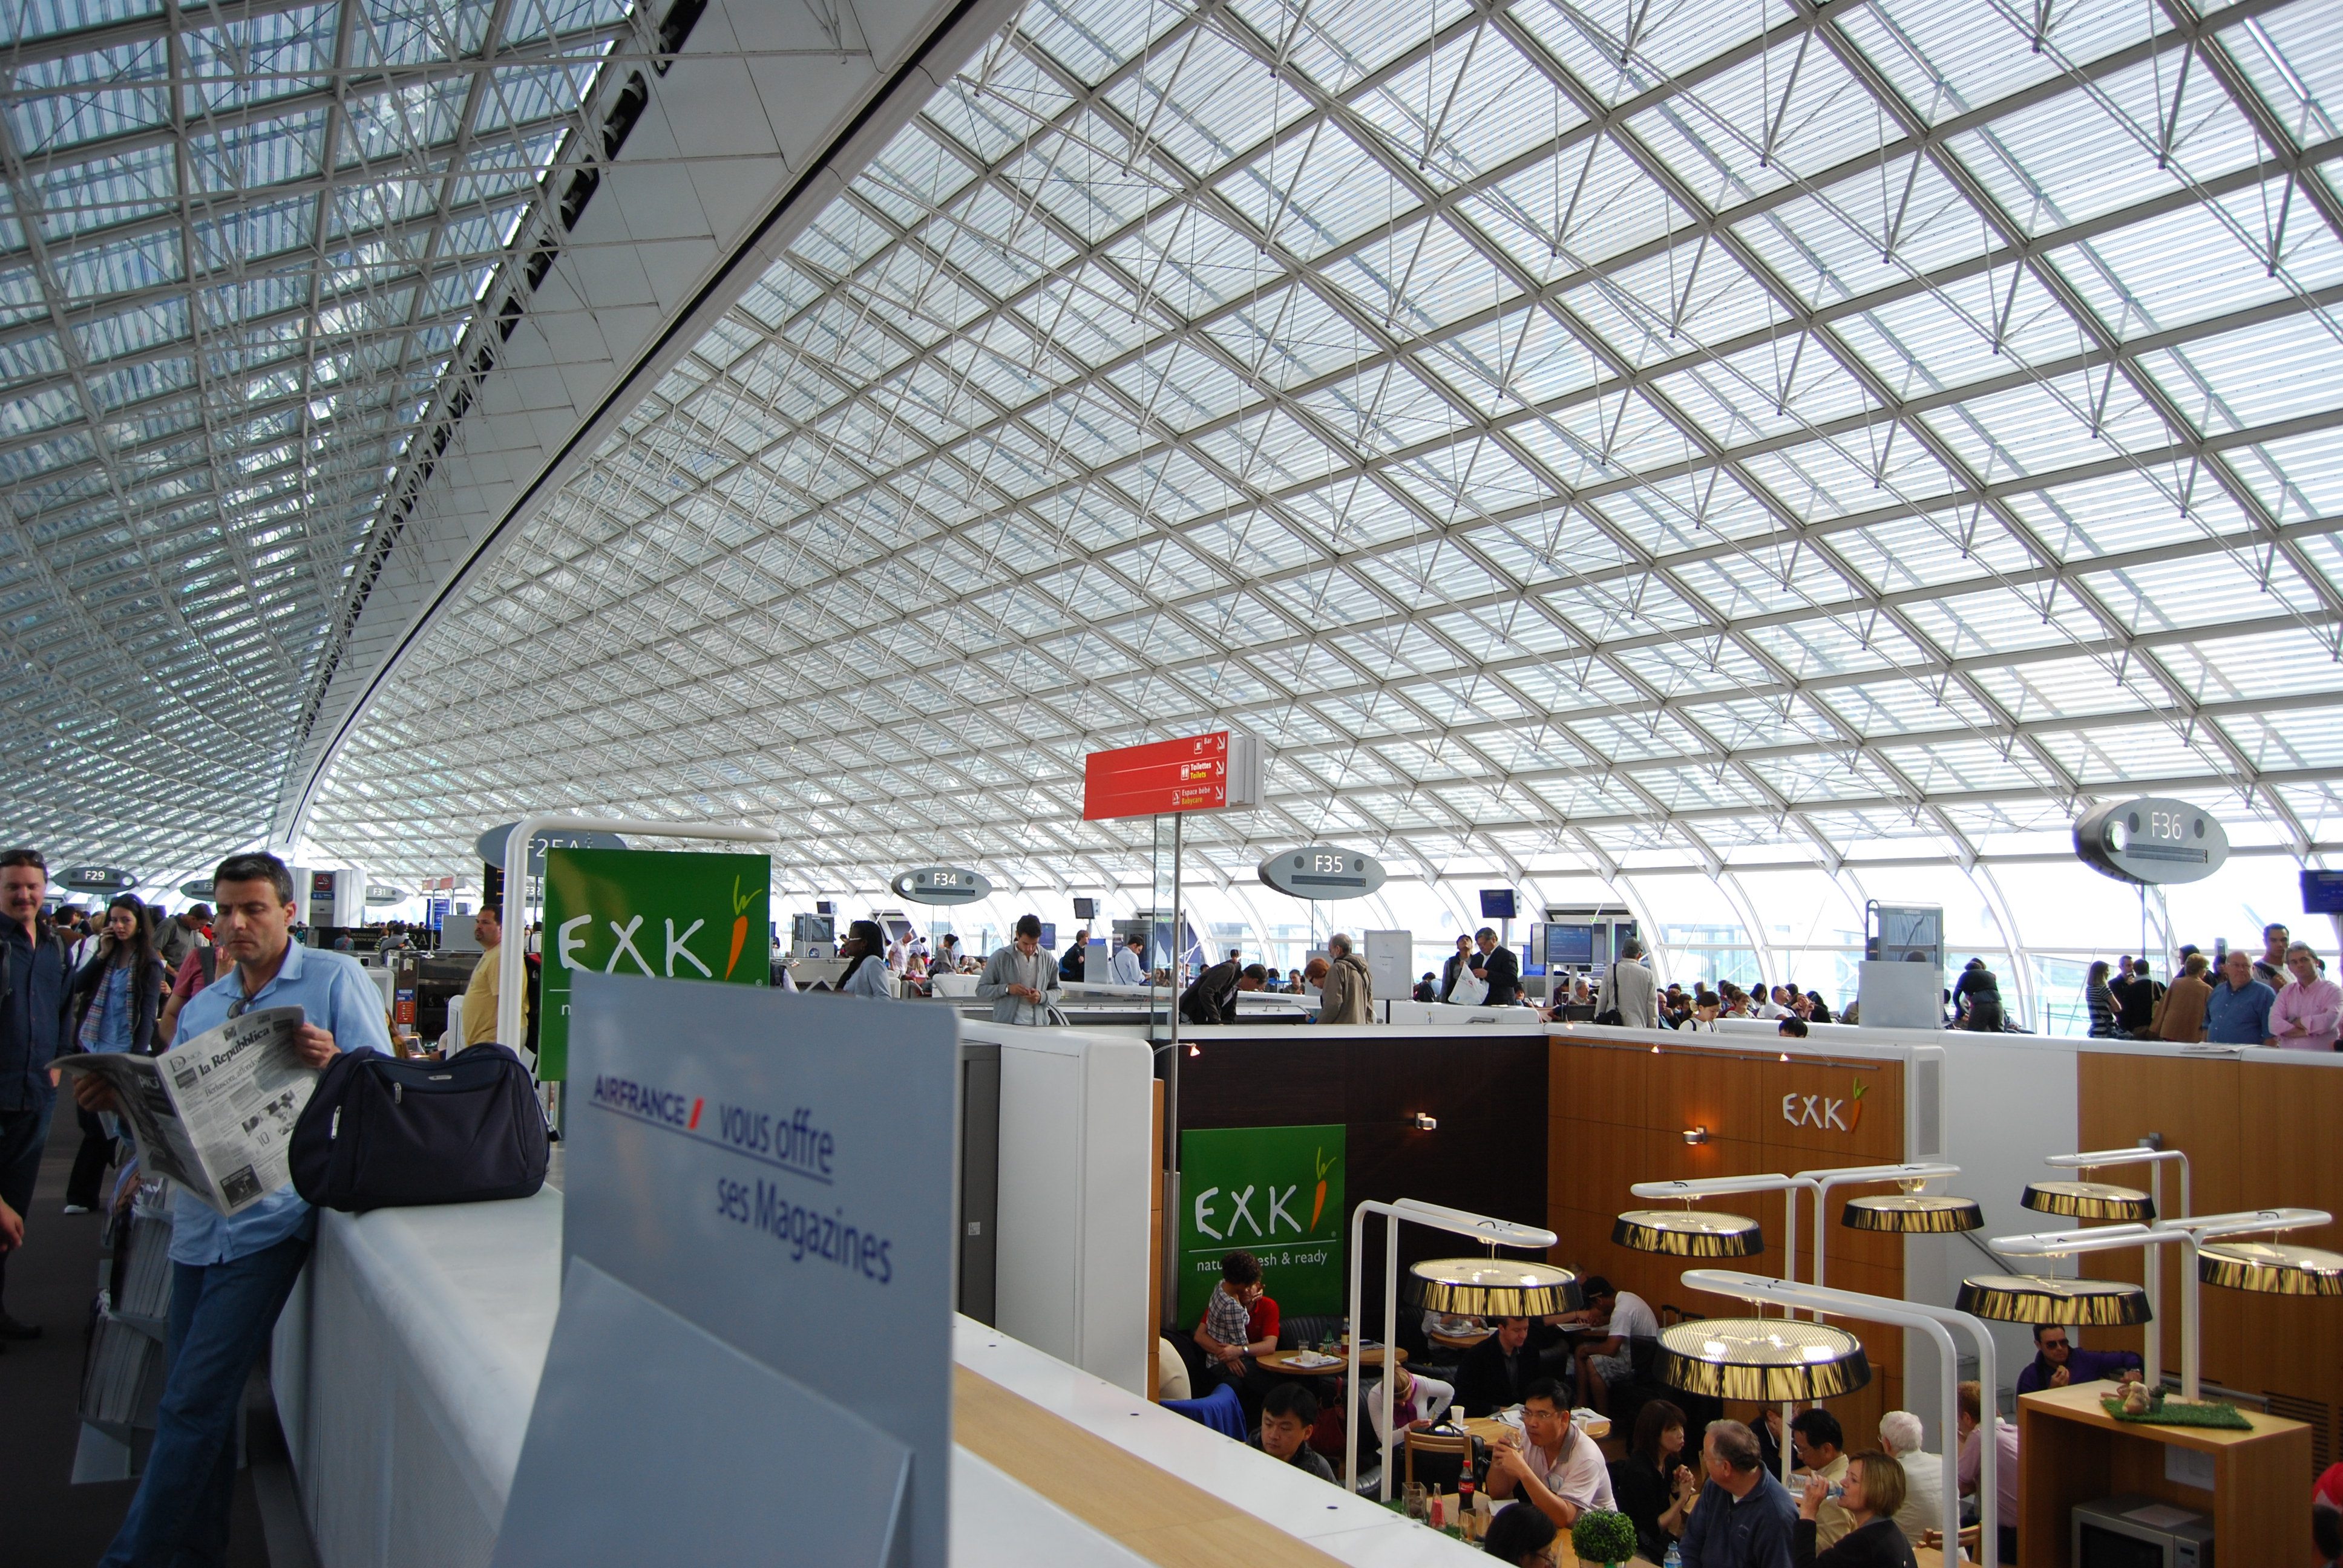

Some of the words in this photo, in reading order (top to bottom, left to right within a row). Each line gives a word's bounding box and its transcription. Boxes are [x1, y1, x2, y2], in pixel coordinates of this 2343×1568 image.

[1190, 762, 1211, 771] Toilettes
[1182, 789, 1198, 797] Espace
[2152, 811, 2182, 840] F36
[1315, 854, 1343, 873] F35
[85, 871, 105, 881] F29
[934, 872, 957, 886] F34
[373, 887, 386, 896] F31
[198, 1063, 211, 1076] la
[211, 1028, 270, 1068] Repubblica
[594, 1075, 686, 1126] AIRFRANCE
[719, 1103, 771, 1153] vous
[776, 1106, 834, 1175] offre
[717, 1177, 750, 1224] ses
[755, 1177, 893, 1284] Magazines
[1197, 1260, 1223, 1272] natu
[1257, 1252, 1277, 1266] esh
[1282, 1252, 1291, 1265] &
[1295, 1249, 1327, 1266] ready
